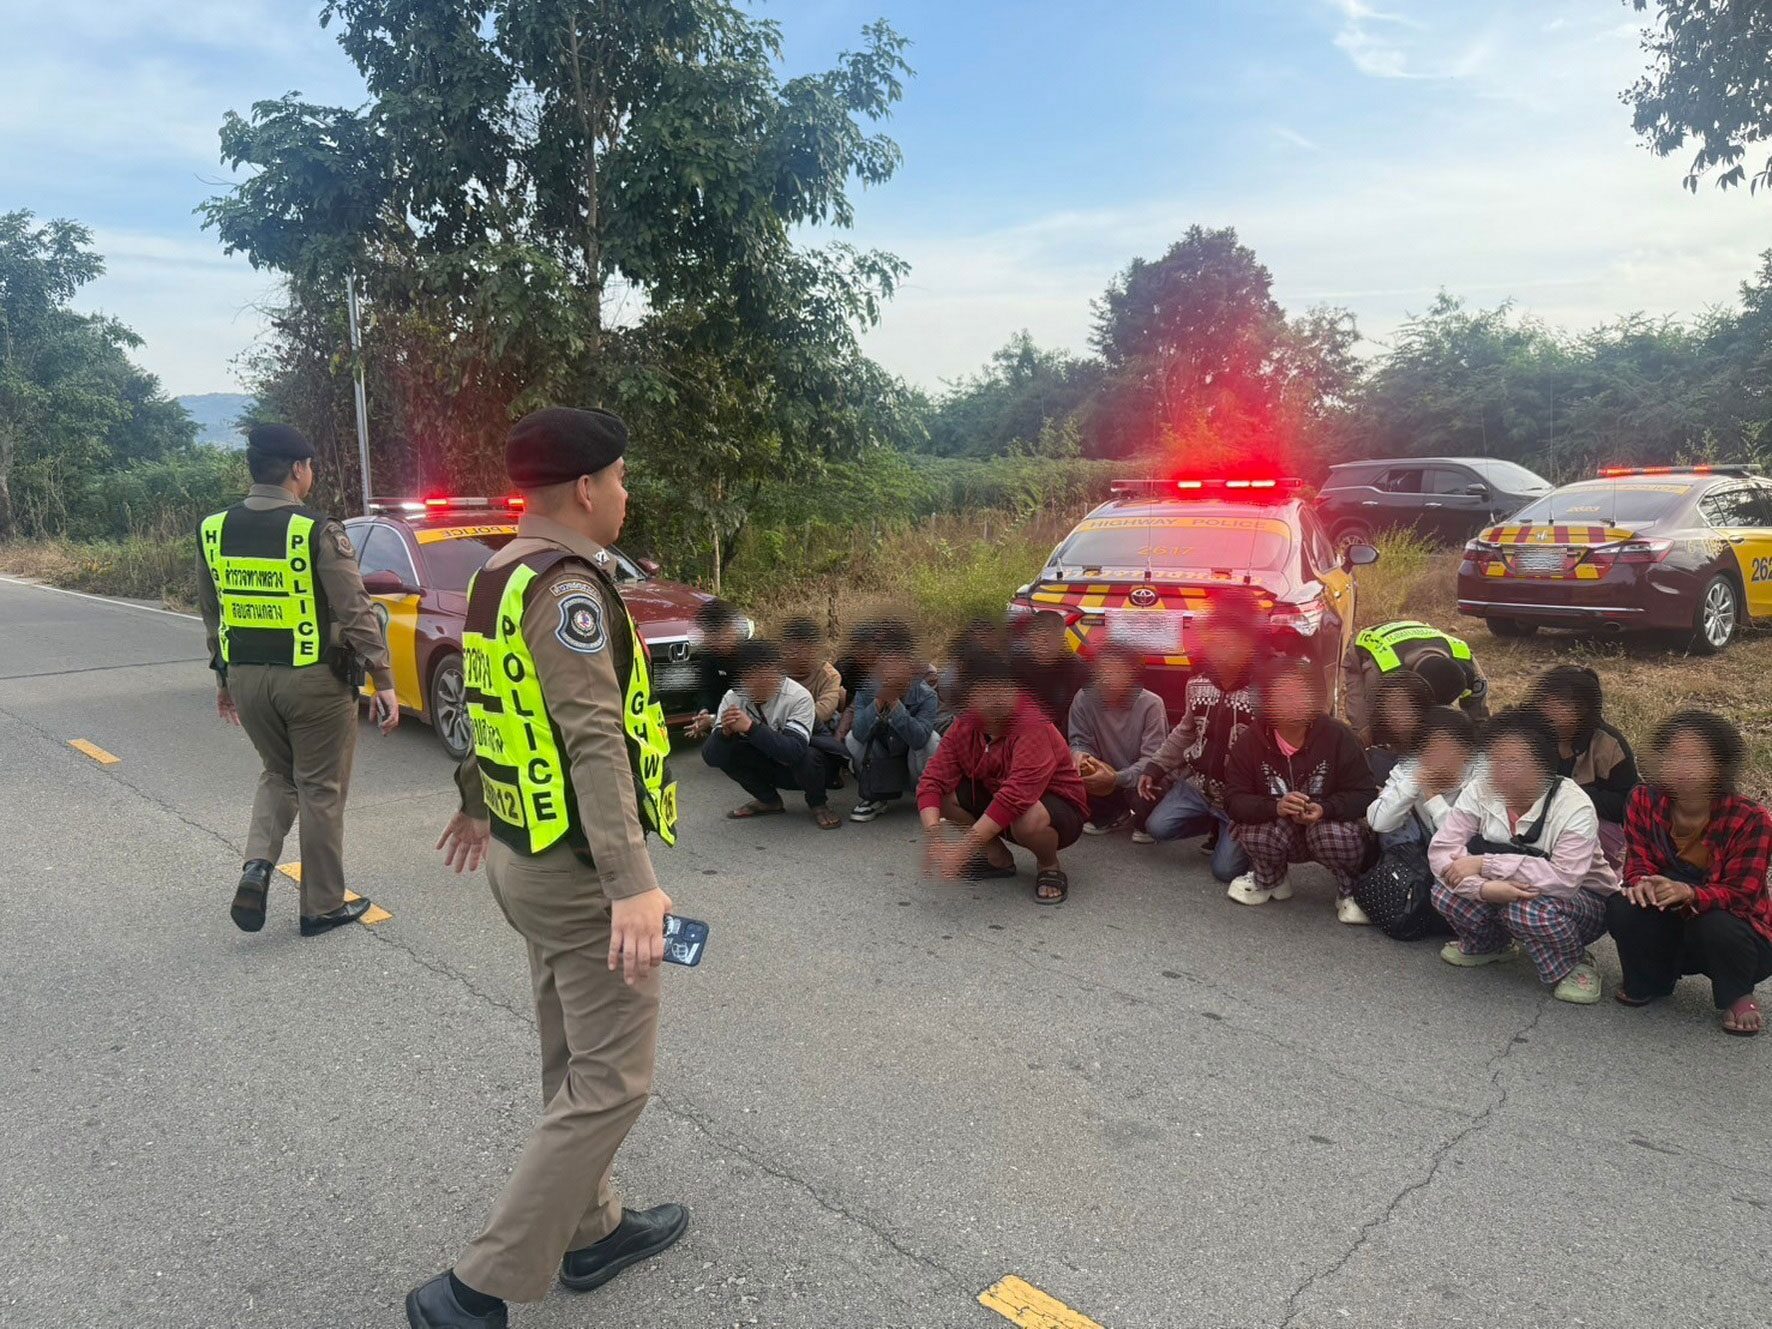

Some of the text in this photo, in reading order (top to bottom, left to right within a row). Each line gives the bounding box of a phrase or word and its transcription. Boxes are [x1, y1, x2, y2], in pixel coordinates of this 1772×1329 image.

[1090, 518, 1267, 528] HIGHWAY POLICE
[290, 535, 314, 656] POLICE
[502, 614, 557, 822] POLICE
